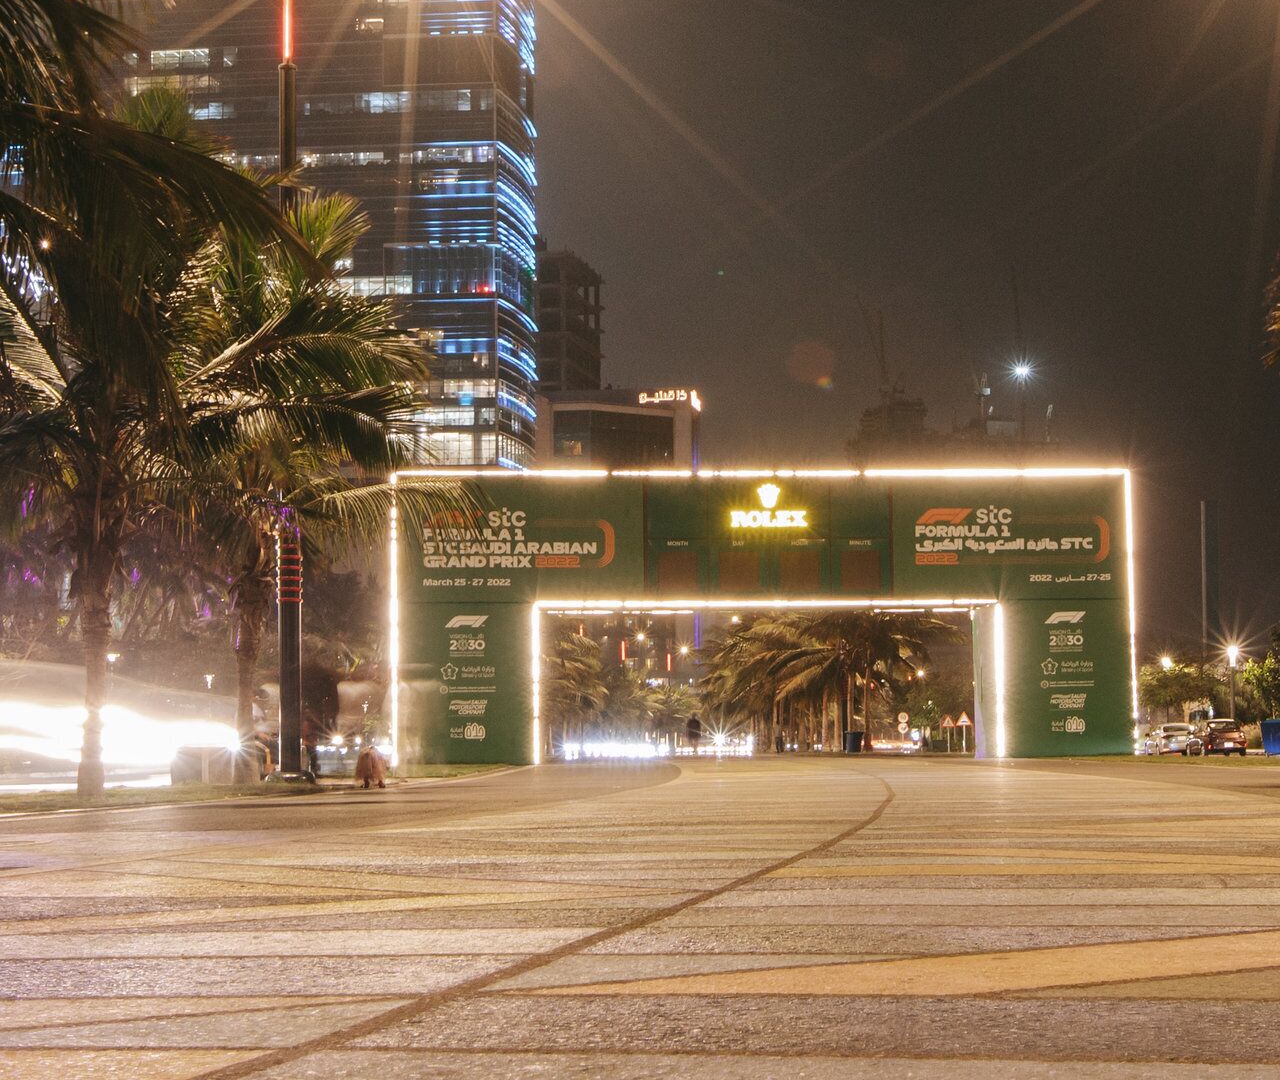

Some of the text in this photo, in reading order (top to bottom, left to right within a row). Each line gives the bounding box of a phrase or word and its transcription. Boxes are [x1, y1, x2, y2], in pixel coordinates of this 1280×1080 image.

[730, 510, 808, 528] ROLEX
[514, 528, 525, 540] 1
[915, 525, 1011, 537] FORMULA 1
[460, 542, 511, 554] SAUDI
[514, 542, 597, 554] ARABIAN
[965, 538, 1024, 554] السعودية
[1060, 537, 1093, 550] STC
[423, 555, 580, 568] GRAND PRIX 2022
[915, 553, 960, 565] 2022
[422, 578, 453, 586] March
[454, 578, 466, 586] 25
[472, 578, 484, 586] 27
[487, 578, 511, 586] 2022
[1030, 574, 1052, 582] 2022
